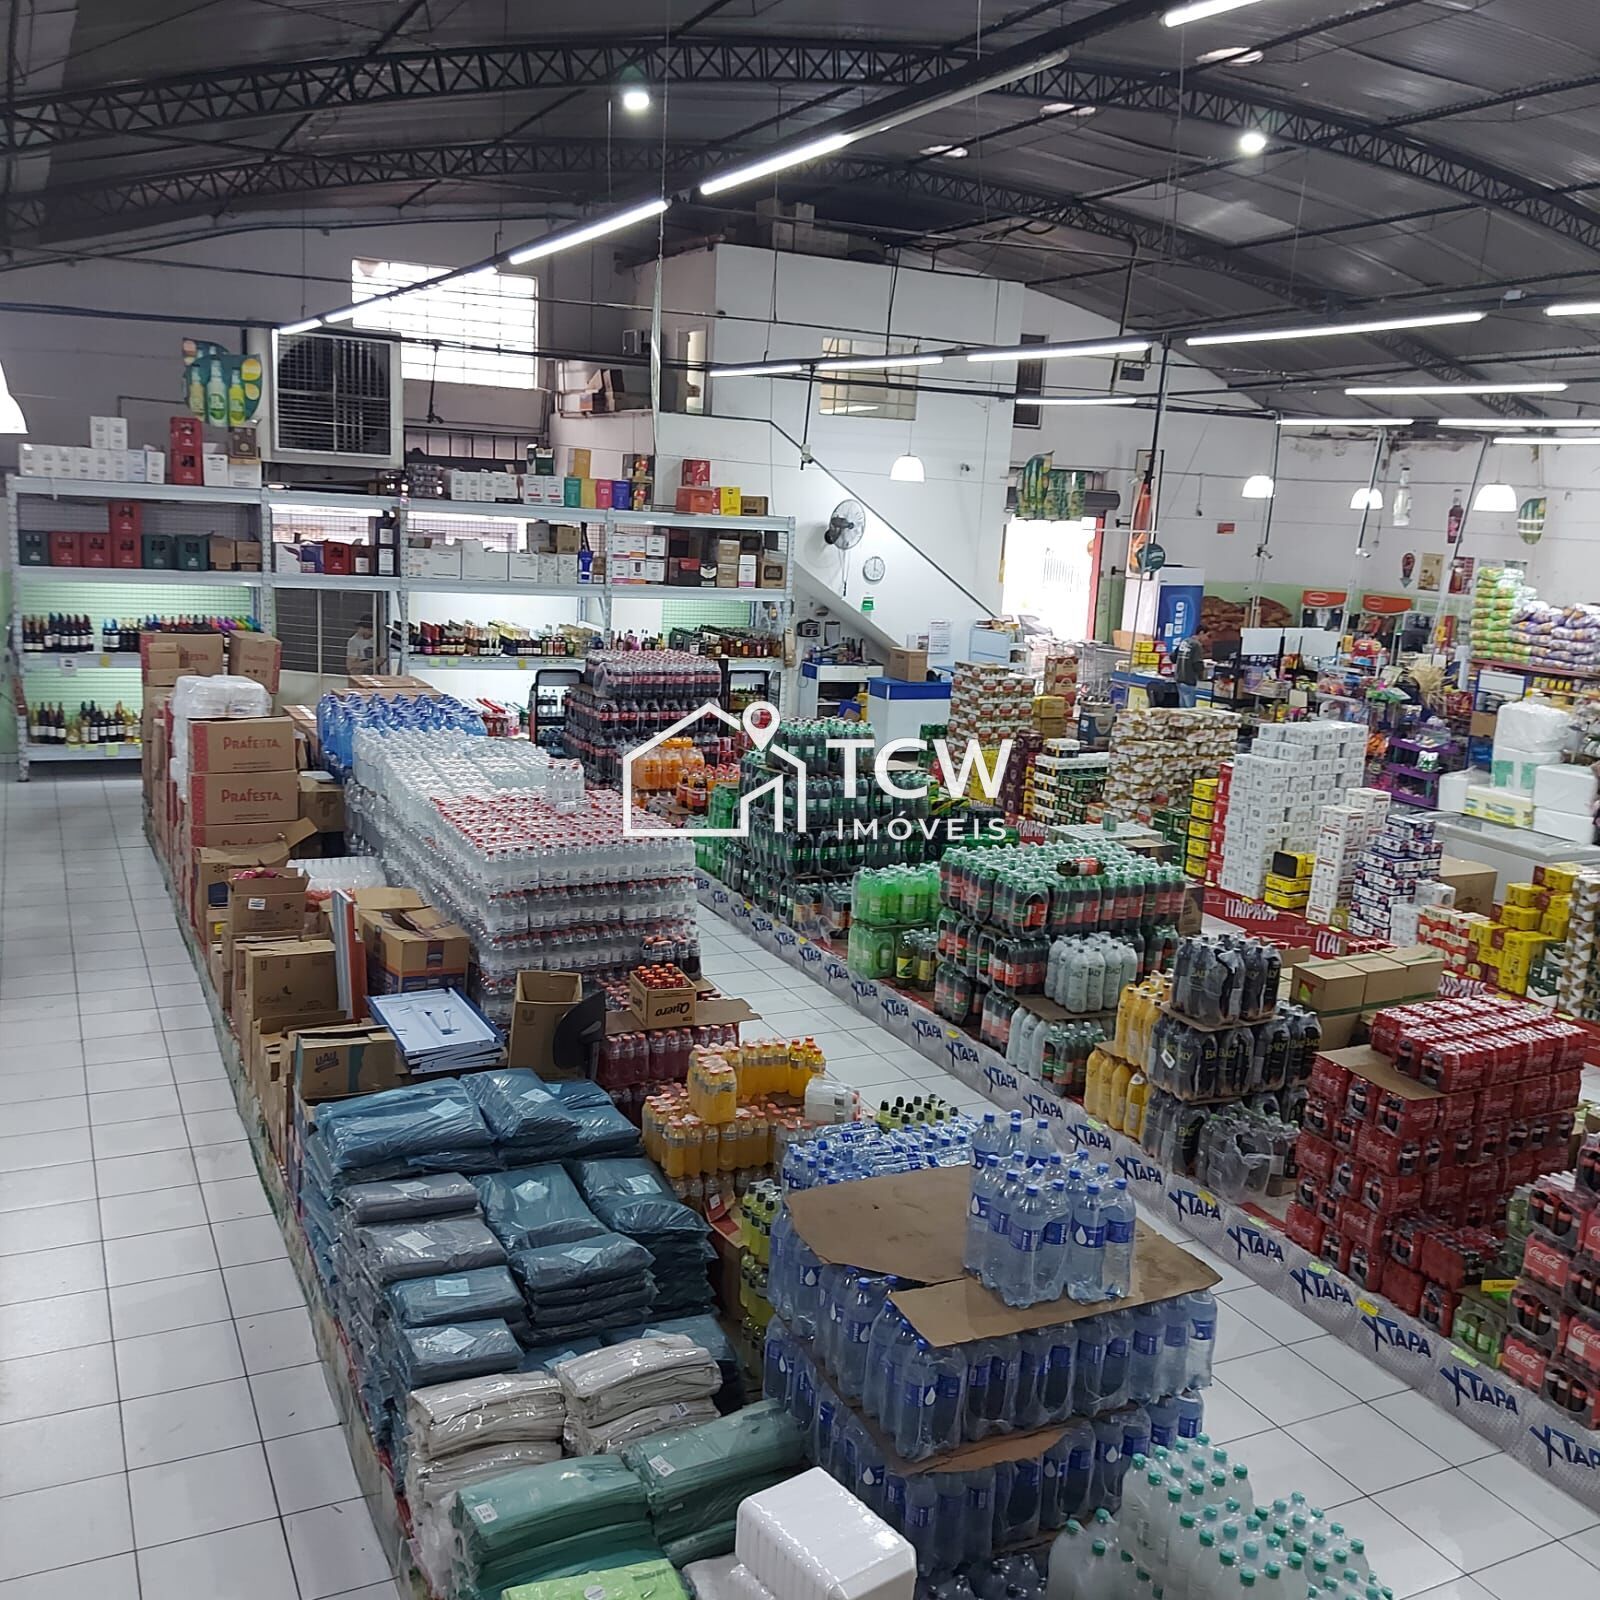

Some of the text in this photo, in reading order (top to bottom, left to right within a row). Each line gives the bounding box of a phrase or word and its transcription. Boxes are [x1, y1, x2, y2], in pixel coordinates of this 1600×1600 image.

[655, 1002, 690, 1017] Quero
[881, 998, 910, 1022] XTAPA
[912, 1019, 942, 1044] XTAPA
[946, 1041, 979, 1068] XTAPA
[984, 1066, 1018, 1094] XTAPA
[1023, 1094, 1063, 1119] XTAPA
[1066, 1123, 1111, 1151] XTAPA
[1115, 1154, 1163, 1186] XTAPA
[1168, 1189, 1221, 1222] XTAPA
[1227, 1226, 1284, 1262] XTAPA
[1289, 1268, 1354, 1307] XTAPA
[1361, 1315, 1432, 1358] XTAPA
[1439, 1366, 1519, 1415] XTAPA
